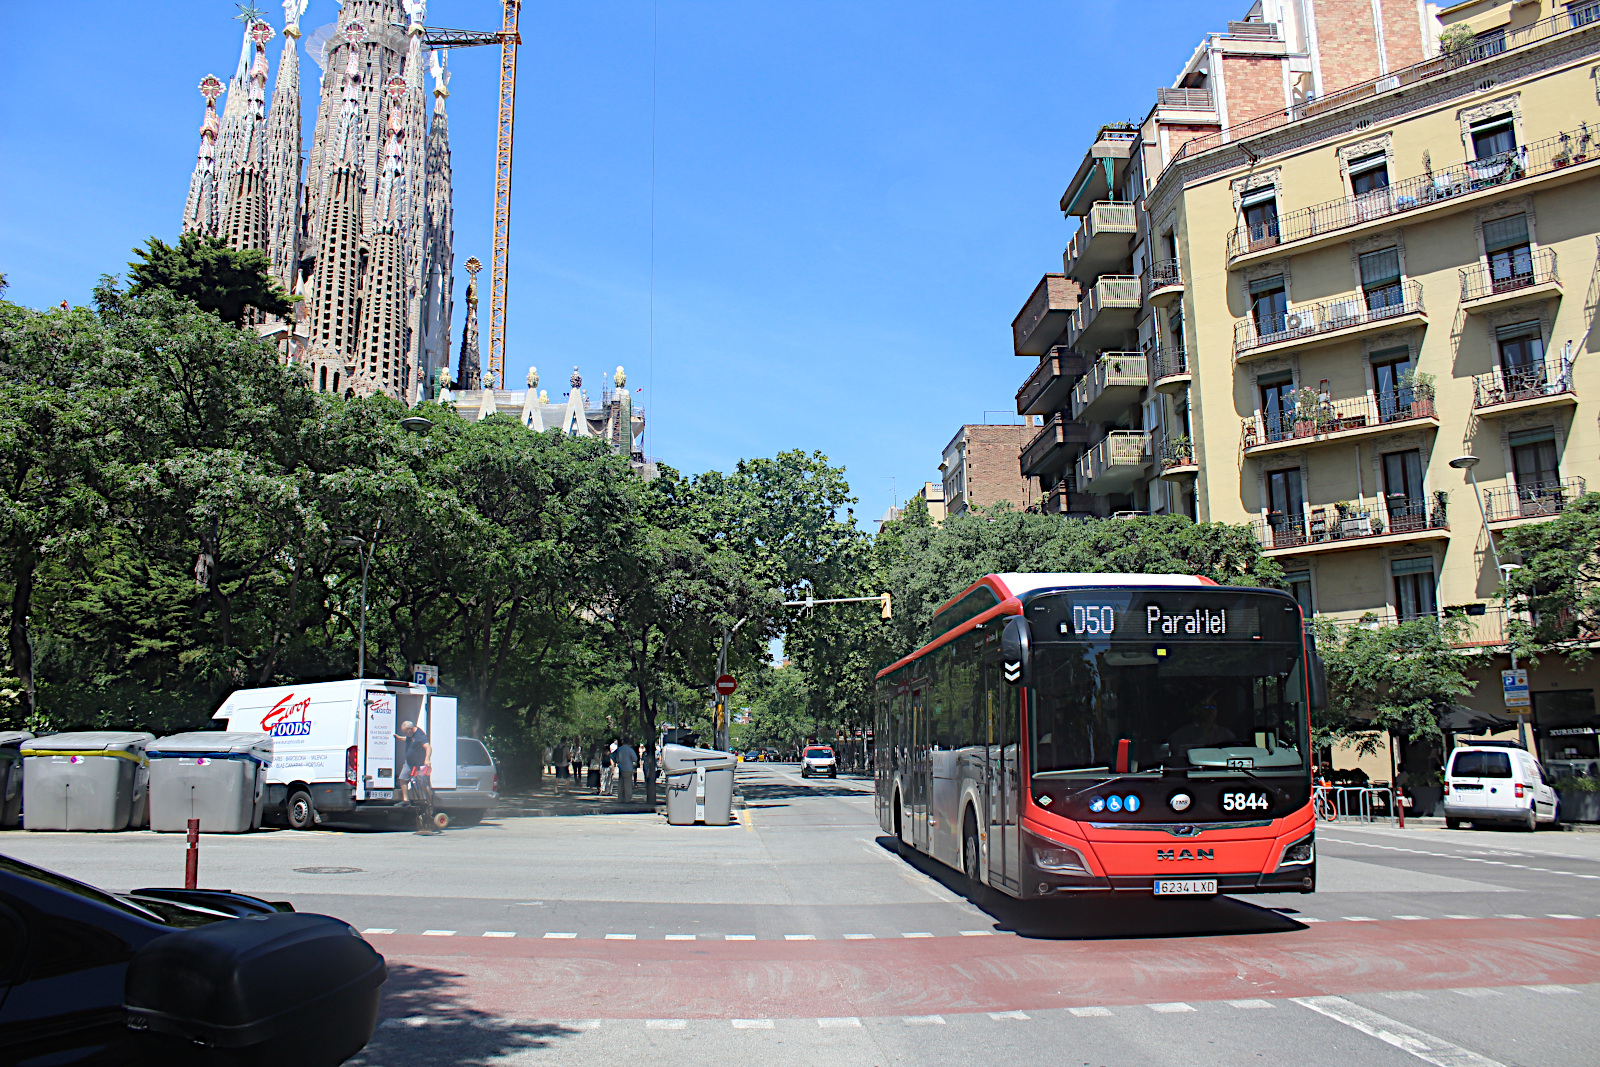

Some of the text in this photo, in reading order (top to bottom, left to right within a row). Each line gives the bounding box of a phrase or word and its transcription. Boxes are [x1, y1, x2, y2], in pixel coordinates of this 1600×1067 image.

[1073, 606, 1115, 634] D50
[270, 722, 311, 736] FOODS
[1223, 793, 1268, 811] 5844
[1157, 848, 1215, 861] MAN
[1161, 881, 1214, 893] 6234 LXD
